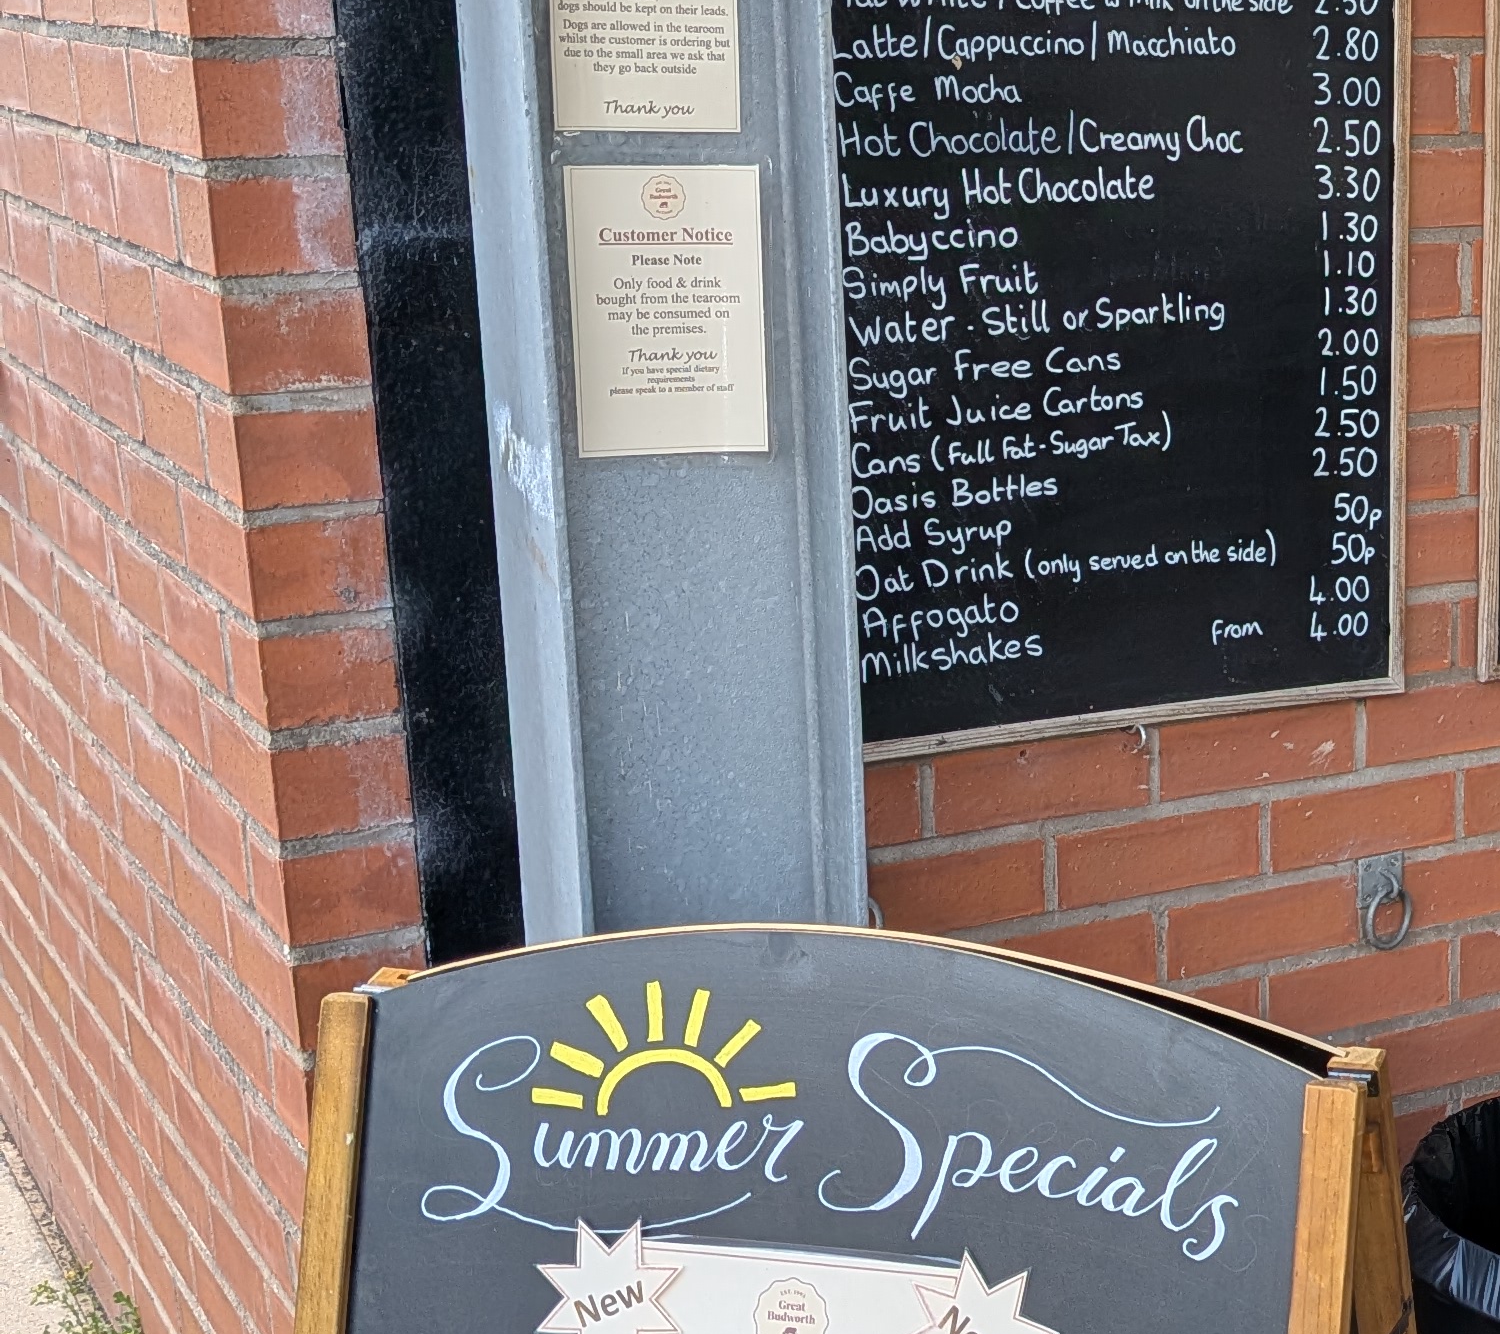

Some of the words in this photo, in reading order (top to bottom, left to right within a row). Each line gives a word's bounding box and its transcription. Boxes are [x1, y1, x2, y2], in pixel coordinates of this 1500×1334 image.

[604, 100, 661, 116] Thank
[661, 103, 695, 118] you
[830, 66, 916, 116] Caffe
[933, 73, 1023, 104] Mocha
[1312, 72, 1381, 107] 3.00
[841, 172, 950, 221] Luxury
[961, 167, 1012, 206] Hot
[1018, 165, 1155, 204] Chocolate
[1314, 164, 1381, 203] 3.30
[844, 218, 1019, 261] Babyccino
[1322, 210, 1379, 243] 1.30
[613, 277, 643, 293] Only
[646, 276, 673, 289] food
[675, 276, 688, 289] &
[690, 276, 721, 289] drink
[838, 262, 947, 314] Simply
[958, 260, 1039, 295] Fruit
[1323, 249, 1375, 278] 1.10
[631, 323, 650, 336] the
[652, 321, 707, 338] premises.
[861, 630, 1043, 684] Milkshakes
[1211, 619, 1264, 646] from
[1309, 610, 1369, 642] 4.00
[422, 1034, 805, 1227] Summer
[818, 1031, 1240, 1262] Specials
[573, 1280, 644, 1328] New
